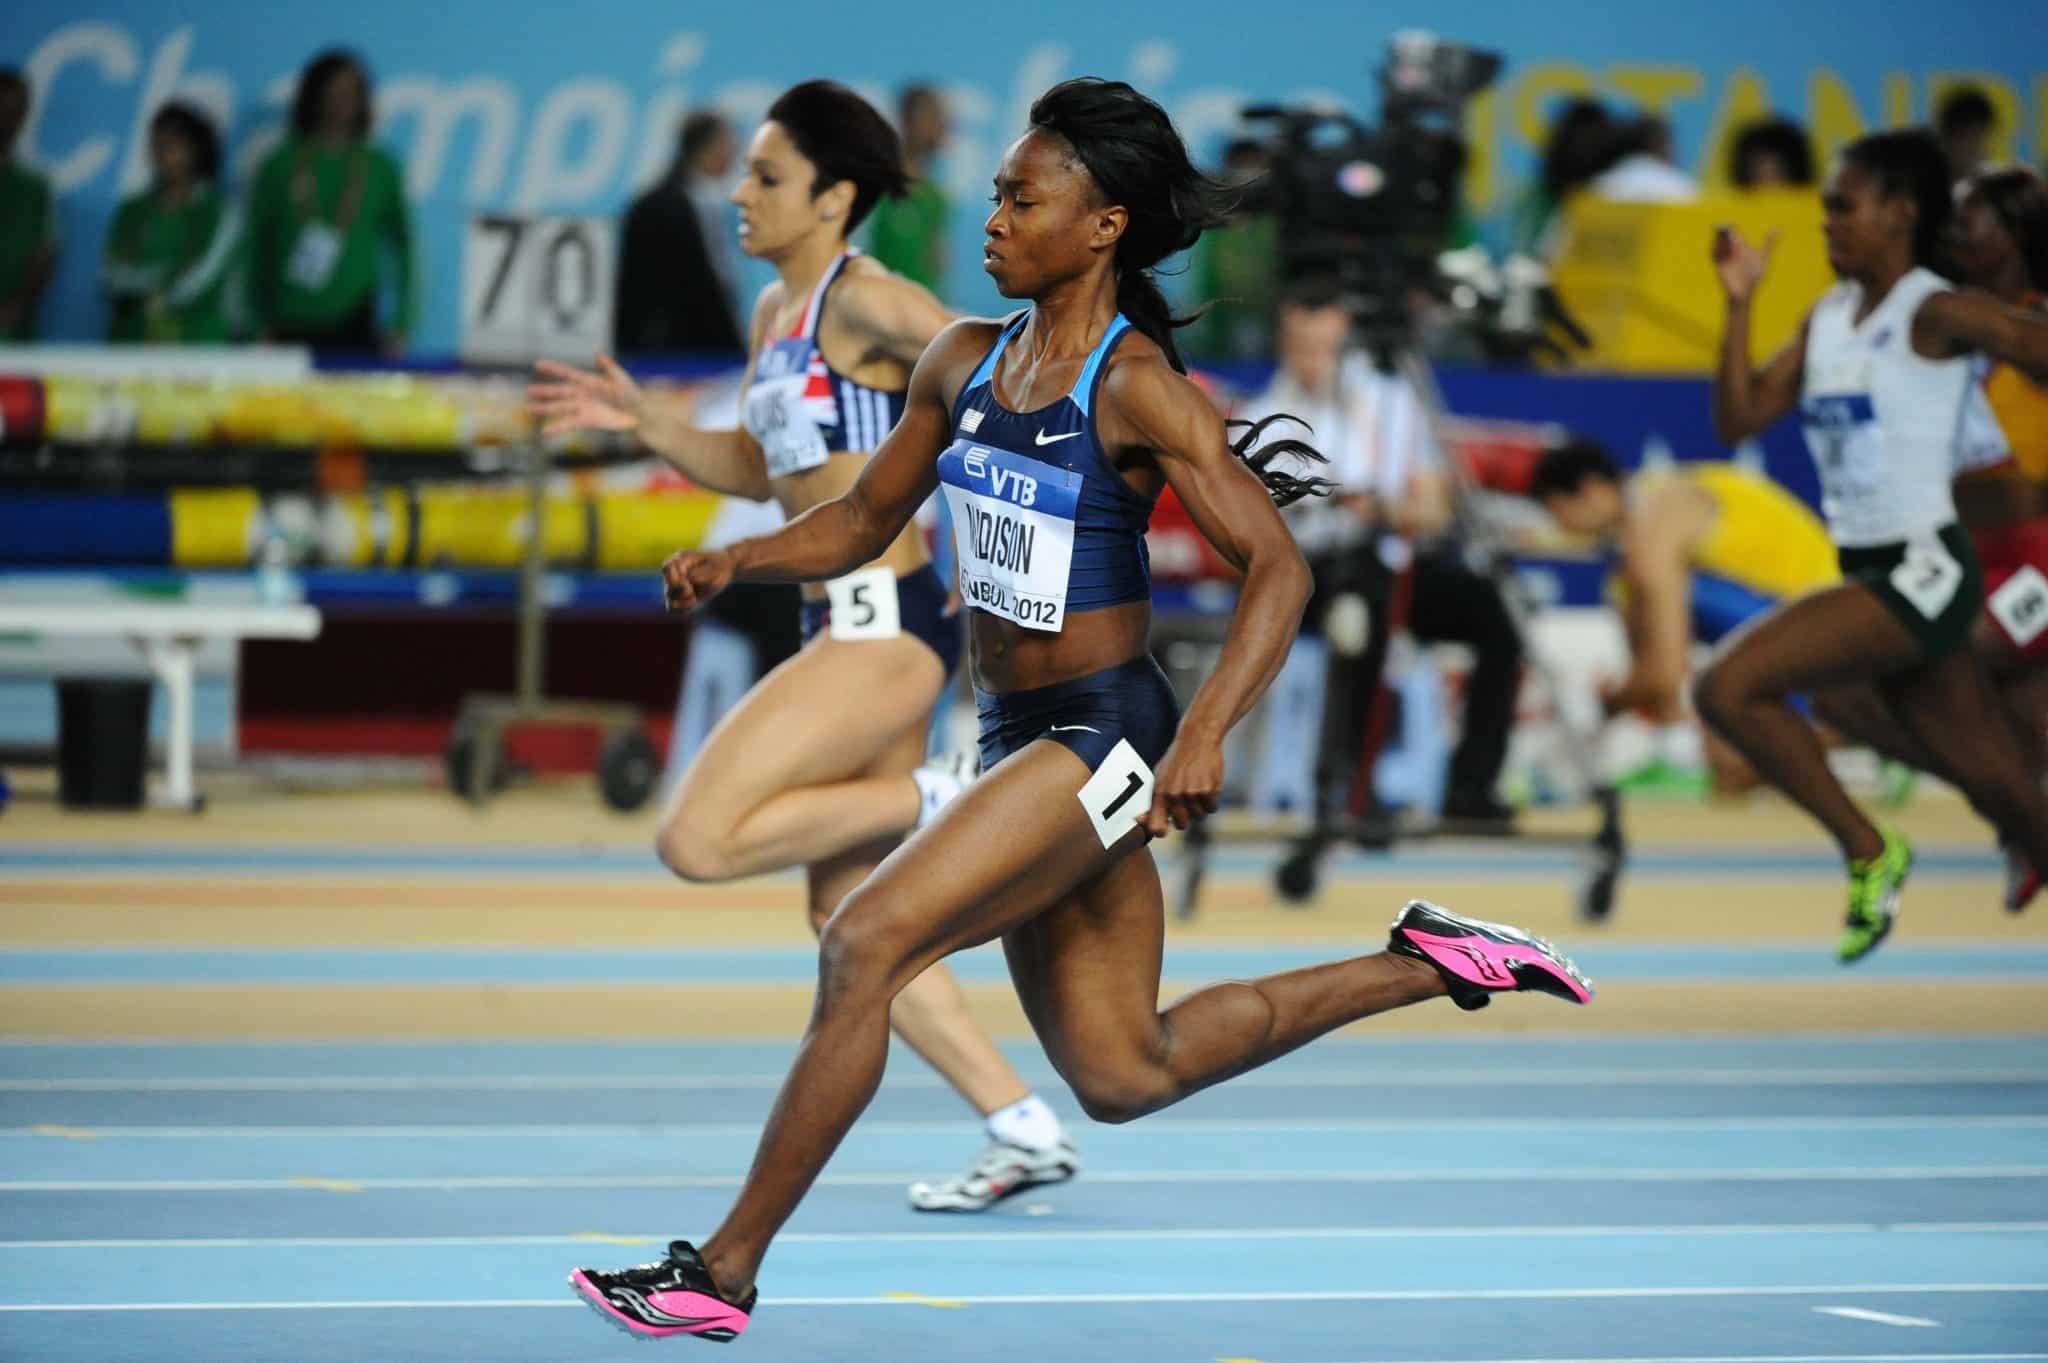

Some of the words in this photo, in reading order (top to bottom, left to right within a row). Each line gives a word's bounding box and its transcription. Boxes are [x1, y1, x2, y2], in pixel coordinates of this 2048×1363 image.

[472, 215, 597, 331] 70
[991, 464, 1038, 507] VTB
[852, 583, 876, 627] 5
[961, 565, 1010, 613] NBUL
[1013, 596, 1057, 623] 2012
[1101, 770, 1145, 821] 1
